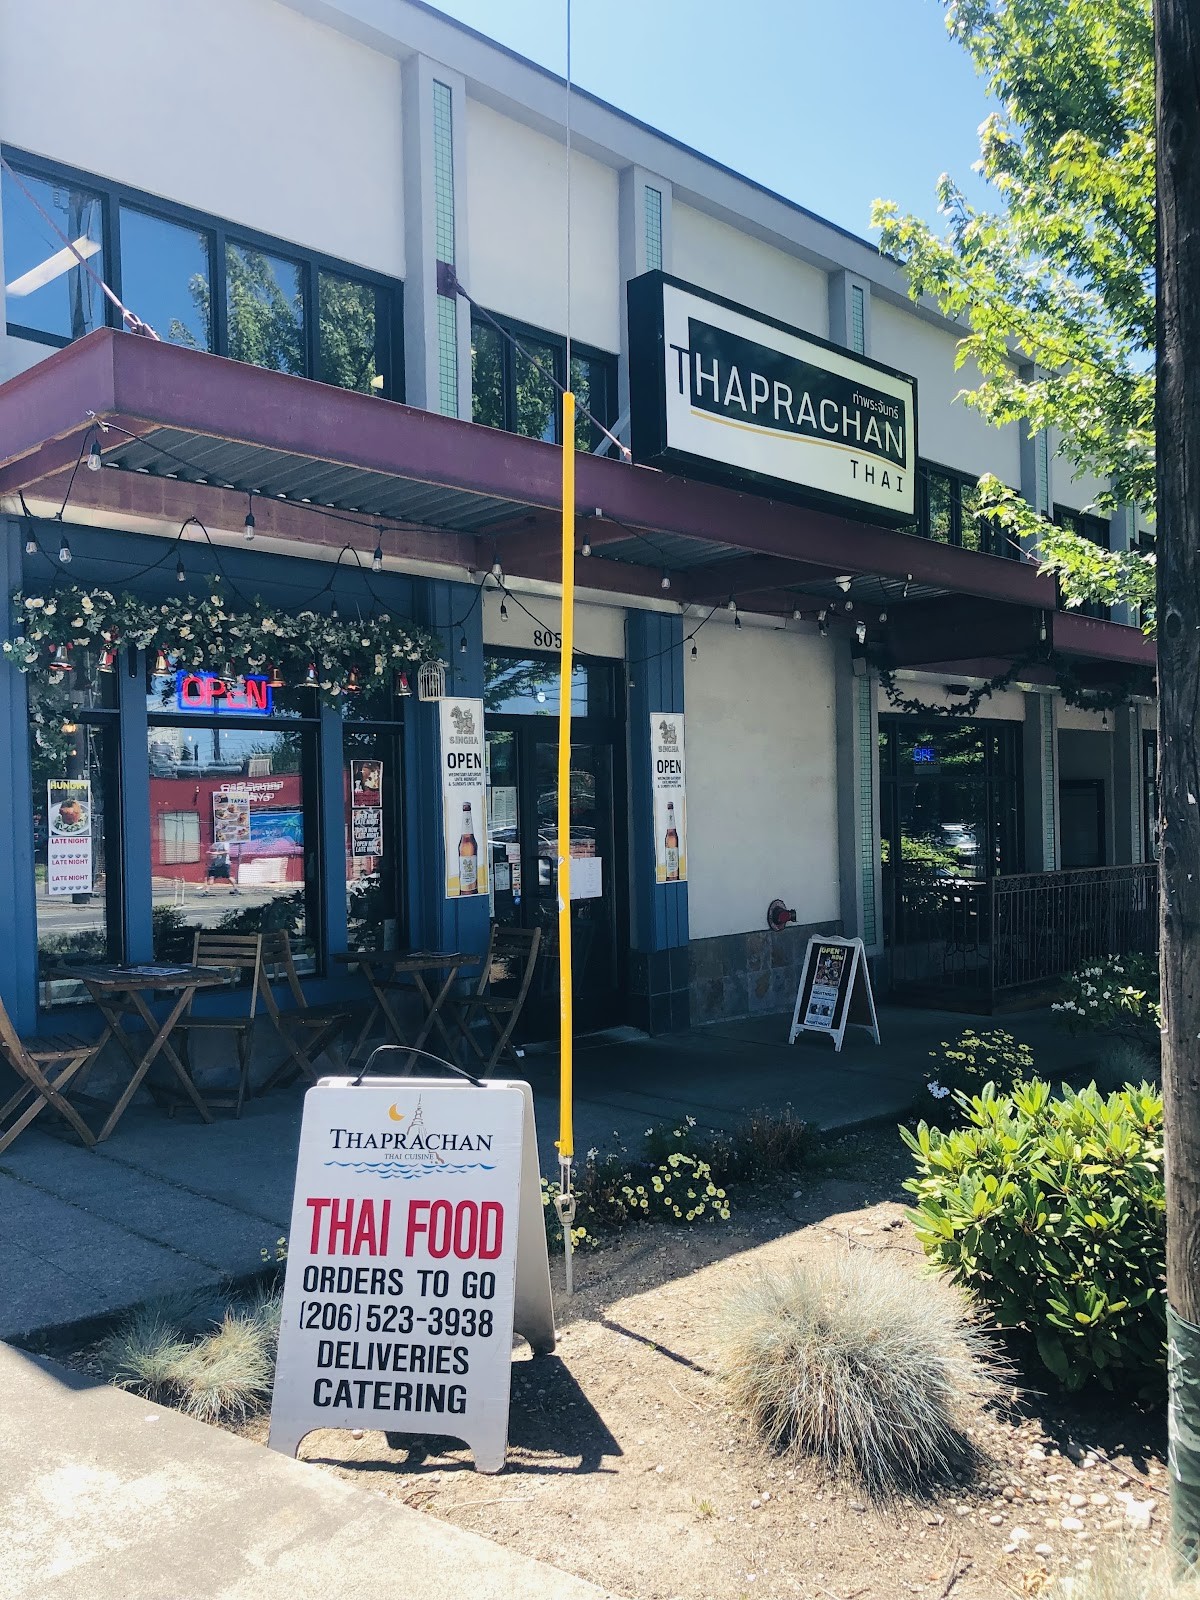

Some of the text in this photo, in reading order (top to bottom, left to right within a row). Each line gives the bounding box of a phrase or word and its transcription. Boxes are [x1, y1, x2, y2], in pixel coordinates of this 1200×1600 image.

[670, 343, 904, 459] THAPRACHAN
[853, 390, 899, 419] ท่าพระจันทร์
[850, 459, 903, 493] THAI
[534, 630, 562, 648] 805
[182, 677, 267, 709] OPEN
[449, 736, 479, 745] SINGHA
[447, 753, 482, 768] OPEN
[657, 760, 682, 773] OPEN
[50, 780, 88, 790] HUNGRY
[821, 947, 840, 955] OPEN
[329, 1128, 493, 1152] THAPRACHAN
[404, 1153, 434, 1161] CUISINE
[306, 1198, 504, 1260] THAI FOOD
[303, 1265, 496, 1299] ORDERS TO GO
[317, 1340, 469, 1374] DELIVERIES
[313, 1378, 467, 1414] CATERING
